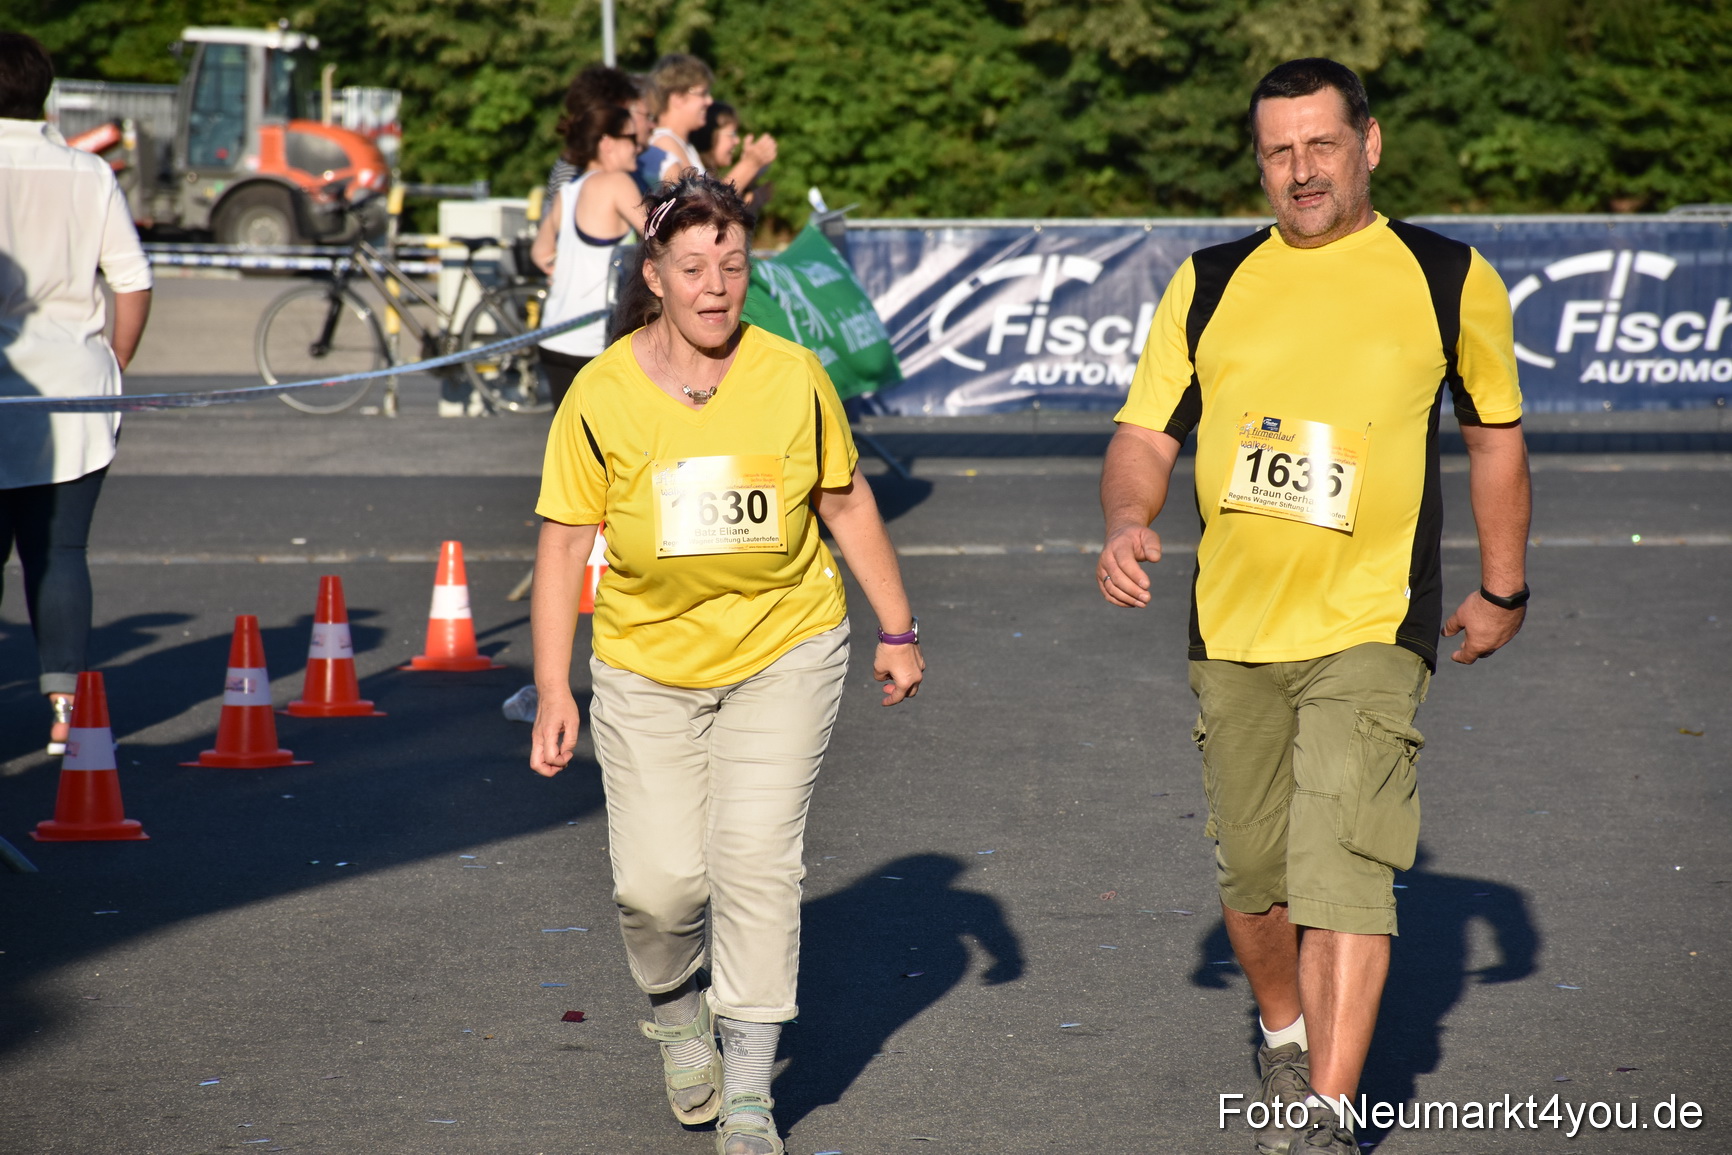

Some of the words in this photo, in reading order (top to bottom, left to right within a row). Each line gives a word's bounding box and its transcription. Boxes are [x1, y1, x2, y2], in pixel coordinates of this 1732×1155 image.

[1580, 359, 1732, 383] AUTOMO
[1246, 449, 1344, 498] 1636
[1228, 492, 1251, 502] Regens
[1253, 496, 1278, 507] Wagner
[1279, 501, 1305, 512] Stiftung
[1252, 486, 1281, 499] Braun
[1285, 491, 1317, 505] Gerha
[695, 527, 716, 537] Batz
[719, 526, 750, 536] Eliane
[715, 536, 741, 544] Stiftung
[743, 535, 780, 543] Lauterhofen
